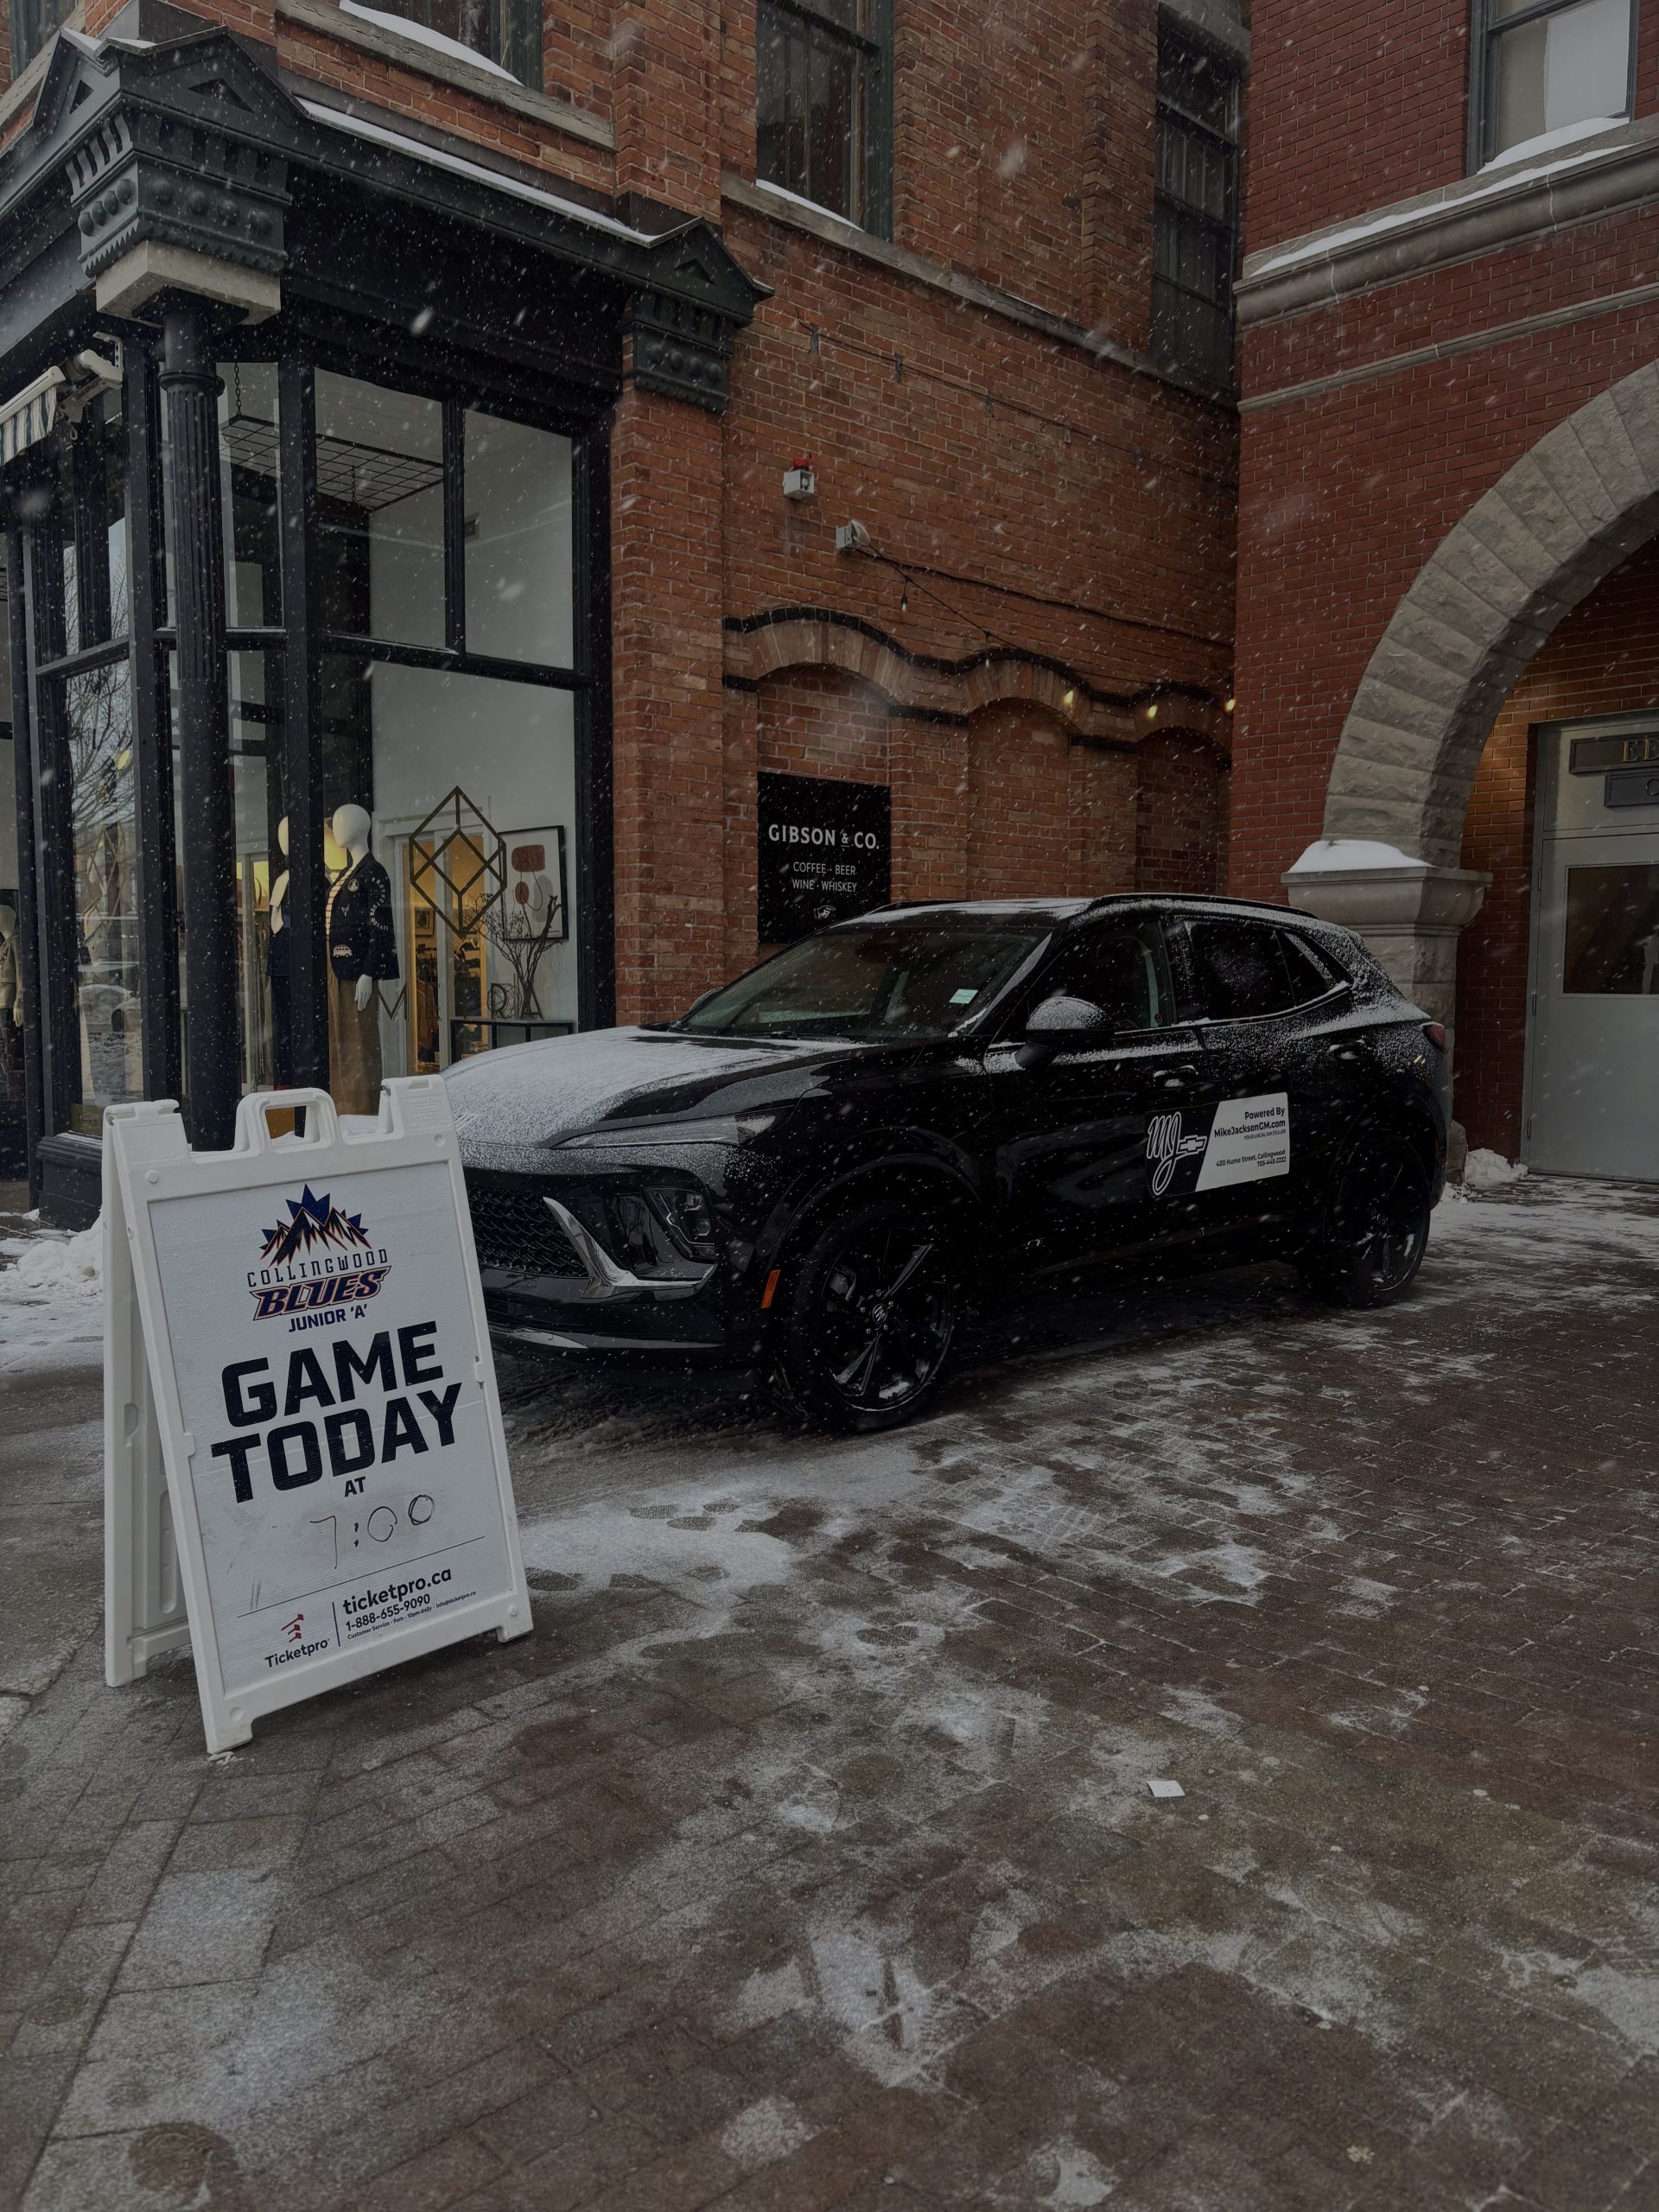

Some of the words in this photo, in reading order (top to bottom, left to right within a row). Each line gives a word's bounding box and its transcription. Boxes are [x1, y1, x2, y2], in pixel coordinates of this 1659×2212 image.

[768, 823, 836, 847] GIBSON
[841, 832, 850, 848] &
[854, 831, 880, 849] CO.
[792, 861, 827, 874] COFFEE
[835, 864, 856, 876] BEER
[791, 879, 815, 890] WINE
[821, 881, 857, 893] WHISKEY
[1244, 1107, 1274, 1121] Powered
[1276, 1107, 1286, 1116] By
[1214, 1120, 1286, 1138] MikeJacksonGM.com
[1242, 1154, 1257, 1163] Street,
[1257, 1148, 1286, 1160] Collingwood
[247, 1249, 388, 1287] COLLINGWOOD
[250, 1266, 391, 1320] BLUES
[289, 1308, 346, 1332] JUNIOR
[222, 1320, 443, 1427] GAME
[210, 1382, 462, 1503] TODAY
[344, 1476, 366, 1497] AT
[343, 1568, 452, 1615] ticketpro.ca
[346, 1593, 430, 1631] 1-888-655-9090
[347, 1628, 372, 1640] Customer
[372, 1622, 390, 1631] Service
[407, 1611, 420, 1619] 10pm
[421, 1605, 432, 1614] daily
[264, 1640, 328, 1668] Ticketpro
